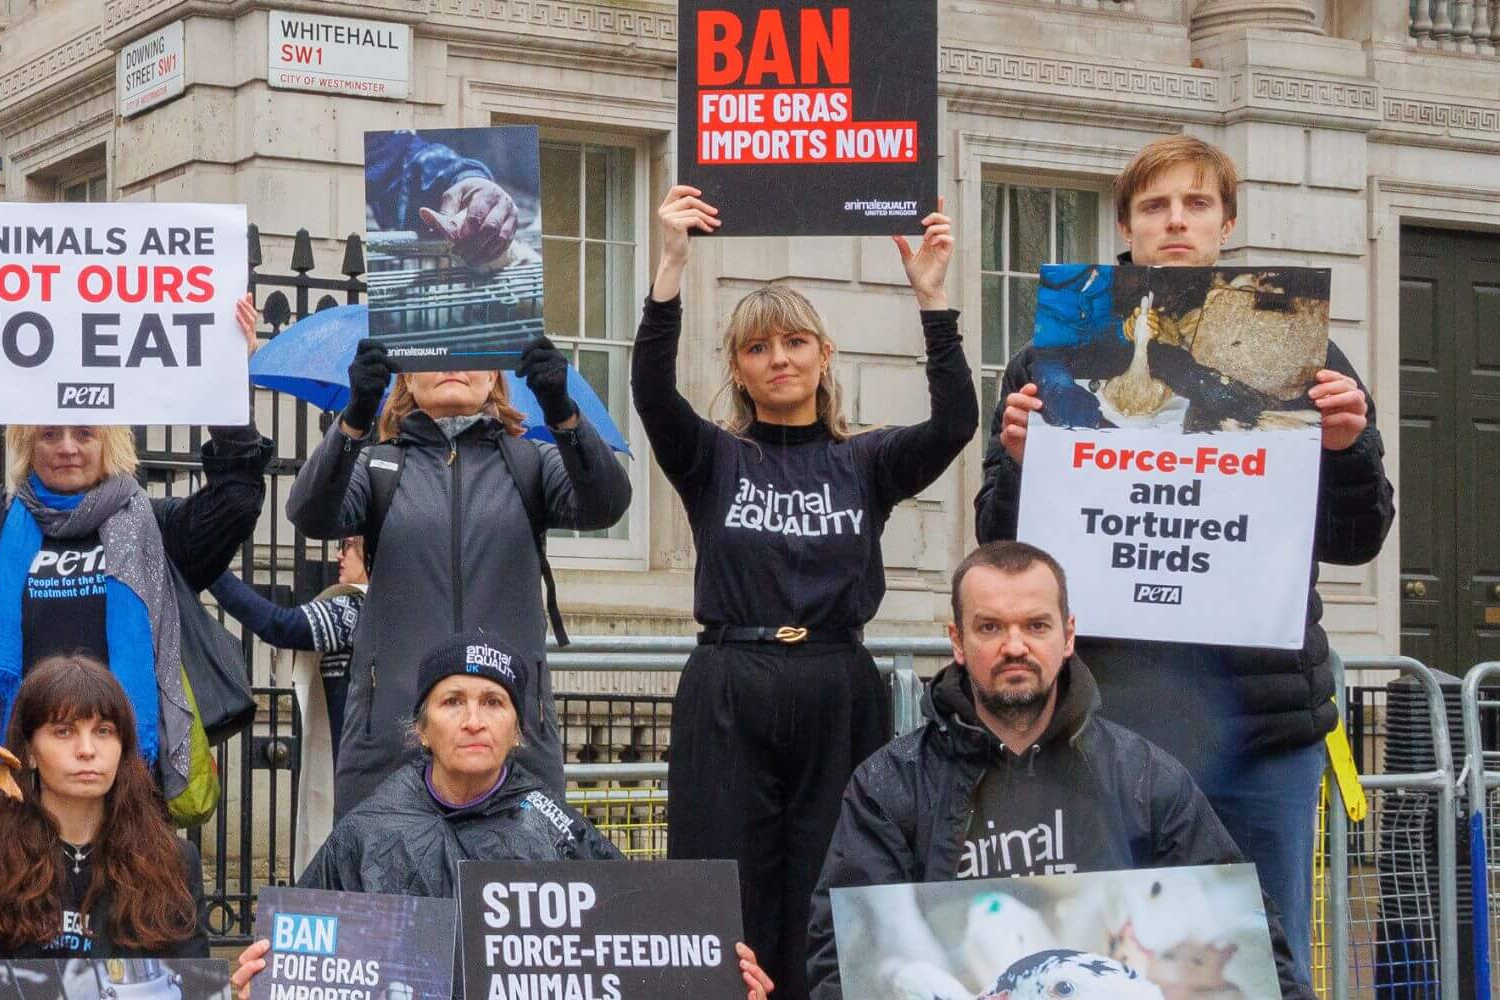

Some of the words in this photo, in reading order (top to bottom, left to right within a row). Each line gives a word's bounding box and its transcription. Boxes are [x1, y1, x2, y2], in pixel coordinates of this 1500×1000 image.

[281, 20, 399, 49] WHITEHALL
[698, 8, 851, 86] BAN
[126, 36, 164, 70] DOWNING
[281, 44, 322, 65] SW1
[126, 62, 155, 91] STREET
[158, 53, 177, 76] SW1
[280, 74, 300, 83] CITY
[303, 76, 316, 85] OF
[320, 78, 385, 92] WESTMINSTER
[702, 93, 765, 124] FOIE
[773, 92, 847, 122] GRAS
[702, 129, 827, 160] IMPORTS
[836, 128, 914, 158] NOW!
[139, 227, 214, 255] ARE
[77, 265, 214, 303] OURS
[81, 313, 215, 367] EAT
[1073, 442, 1266, 476] Force-Fed
[735, 478, 832, 516] animal
[1129, 479, 1202, 507] and
[725, 505, 864, 537] EQUALITY
[1081, 508, 1248, 542] Tortured
[1111, 542, 1210, 574] Birds
[28, 578, 59, 587] People
[62, 577, 75, 586] for
[78, 576, 94, 585] the
[29, 588, 77, 598] Treatment
[80, 586, 89, 596] of
[466, 643, 512, 667] animal
[466, 653, 517, 682] EQUALITY
[466, 664, 479, 672] UK
[482, 882, 596, 928] STOP
[276, 916, 334, 952] BAN
[484, 934, 722, 967] FORCE-FEEDING
[272, 953, 318, 981] FOIE
[322, 957, 380, 986] GRAS
[488, 974, 622, 1000] ANIMALS
